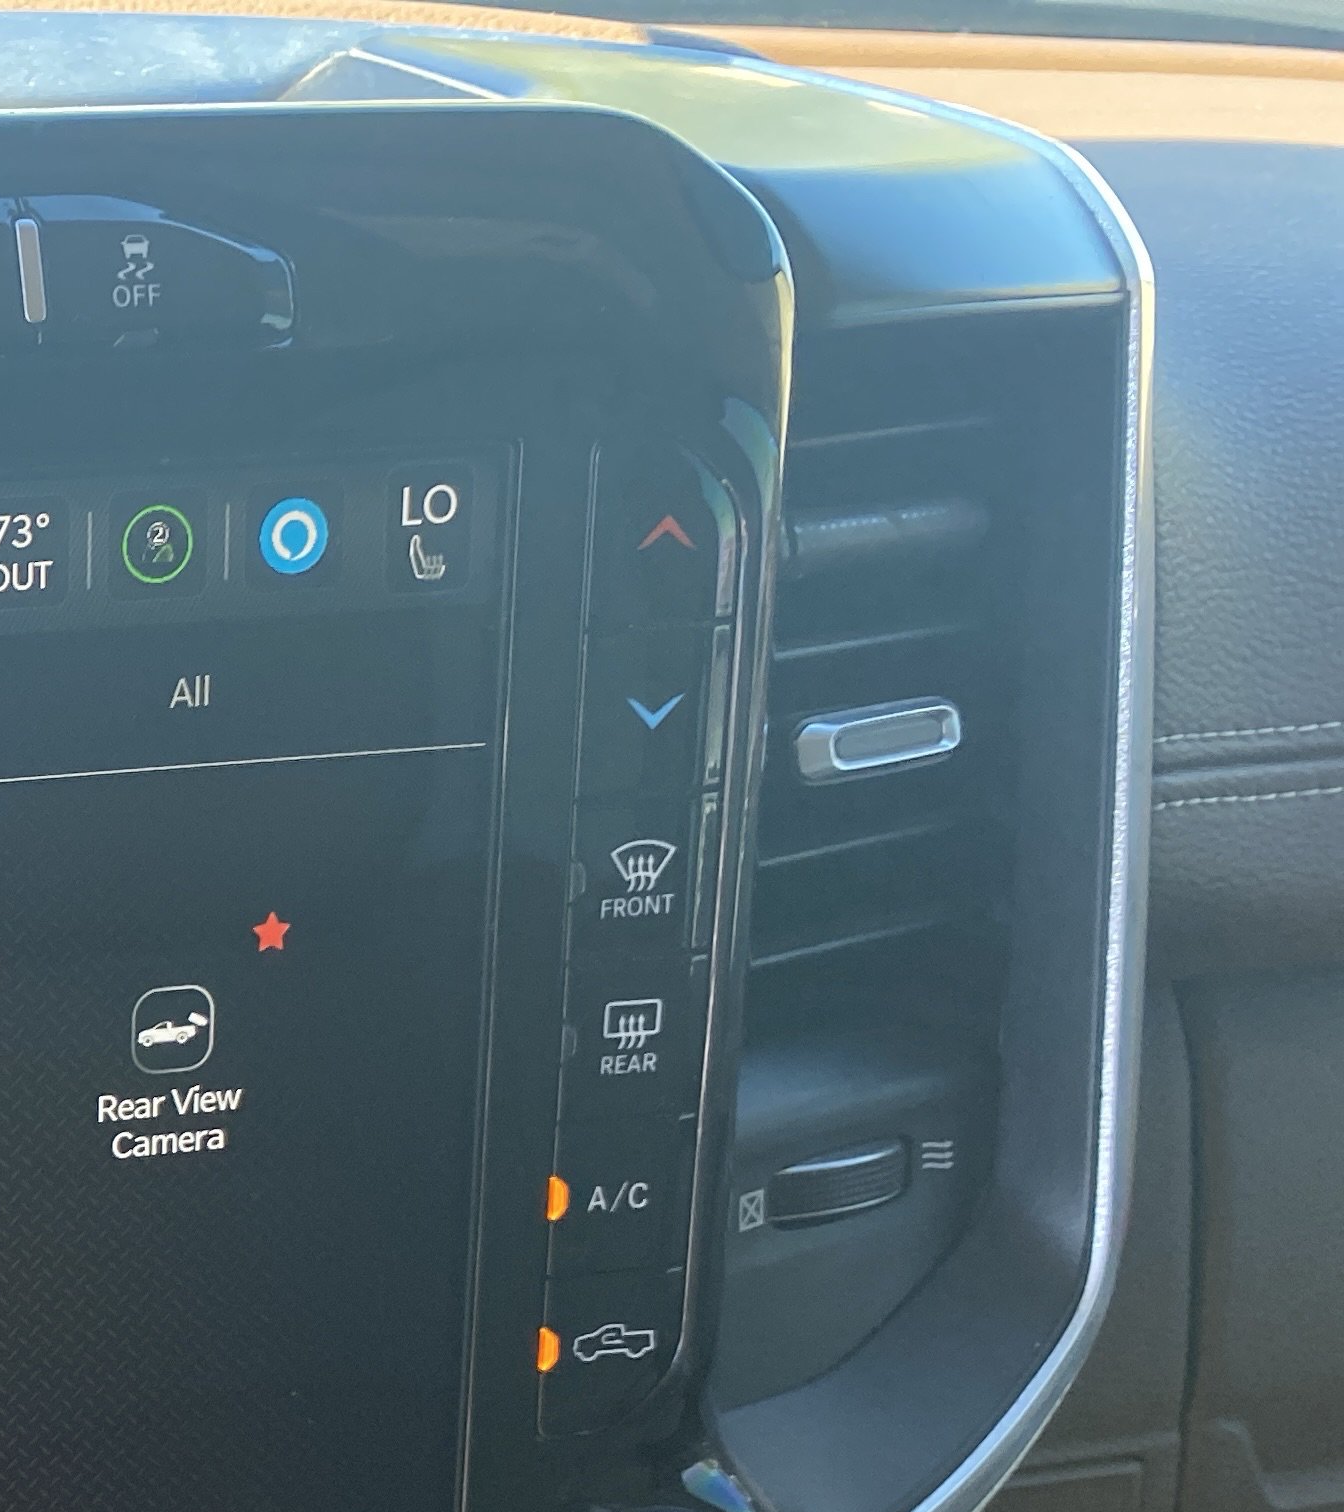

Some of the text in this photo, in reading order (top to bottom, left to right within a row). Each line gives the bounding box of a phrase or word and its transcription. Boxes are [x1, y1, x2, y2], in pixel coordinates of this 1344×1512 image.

[112, 282, 161, 310] OFF
[401, 483, 458, 526] LO
[168, 674, 211, 709] All
[600, 893, 675, 919] FRONT
[600, 1053, 657, 1075] REAR
[97, 1084, 242, 1122] Rear View
[111, 1126, 226, 1159] Camera
[587, 1182, 649, 1213] A/C
